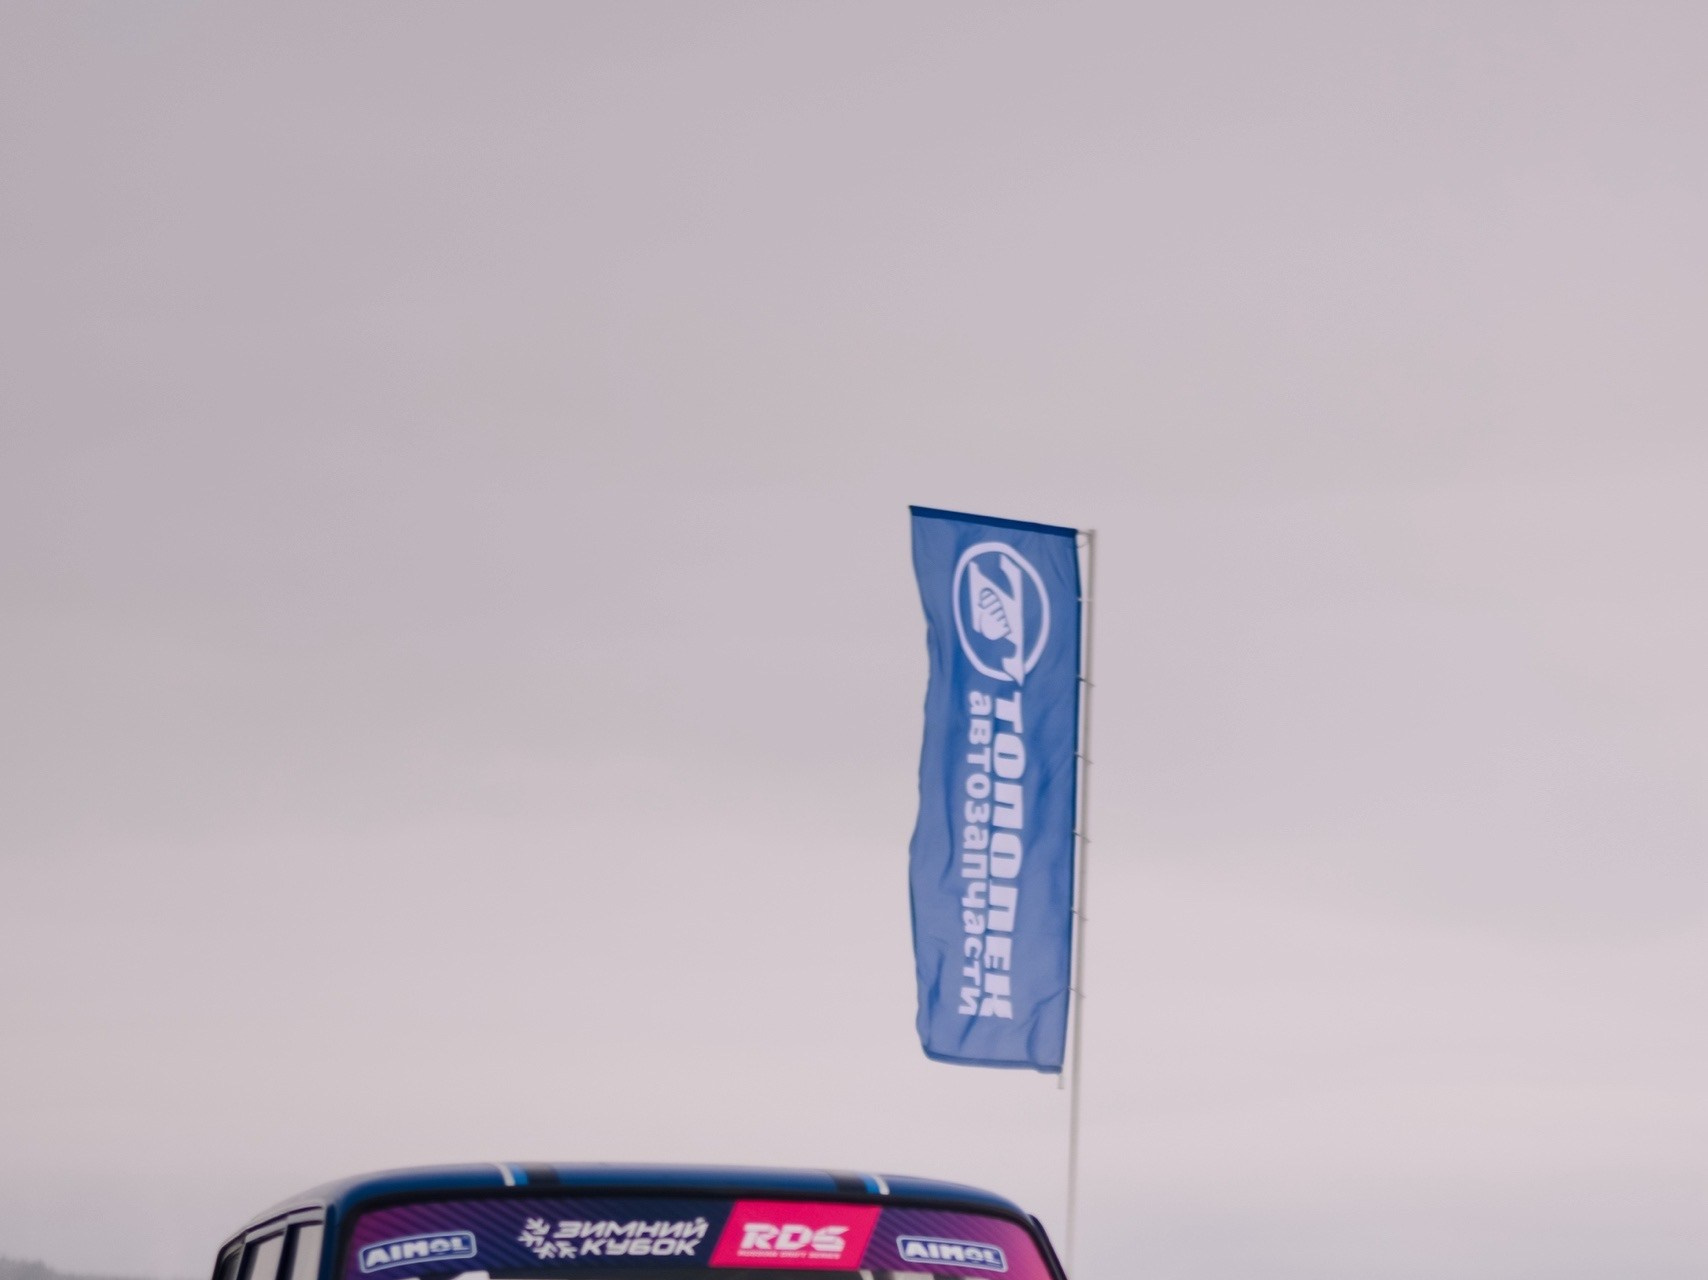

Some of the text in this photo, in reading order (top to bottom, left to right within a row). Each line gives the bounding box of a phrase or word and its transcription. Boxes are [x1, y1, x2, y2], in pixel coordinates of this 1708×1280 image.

[958, 690, 992, 1016] автозапчасти
[552, 1216, 709, 1239] ЗИМНИЙ
[740, 1223, 850, 1252] RDS
[580, 1238, 701, 1256] КУБОК
